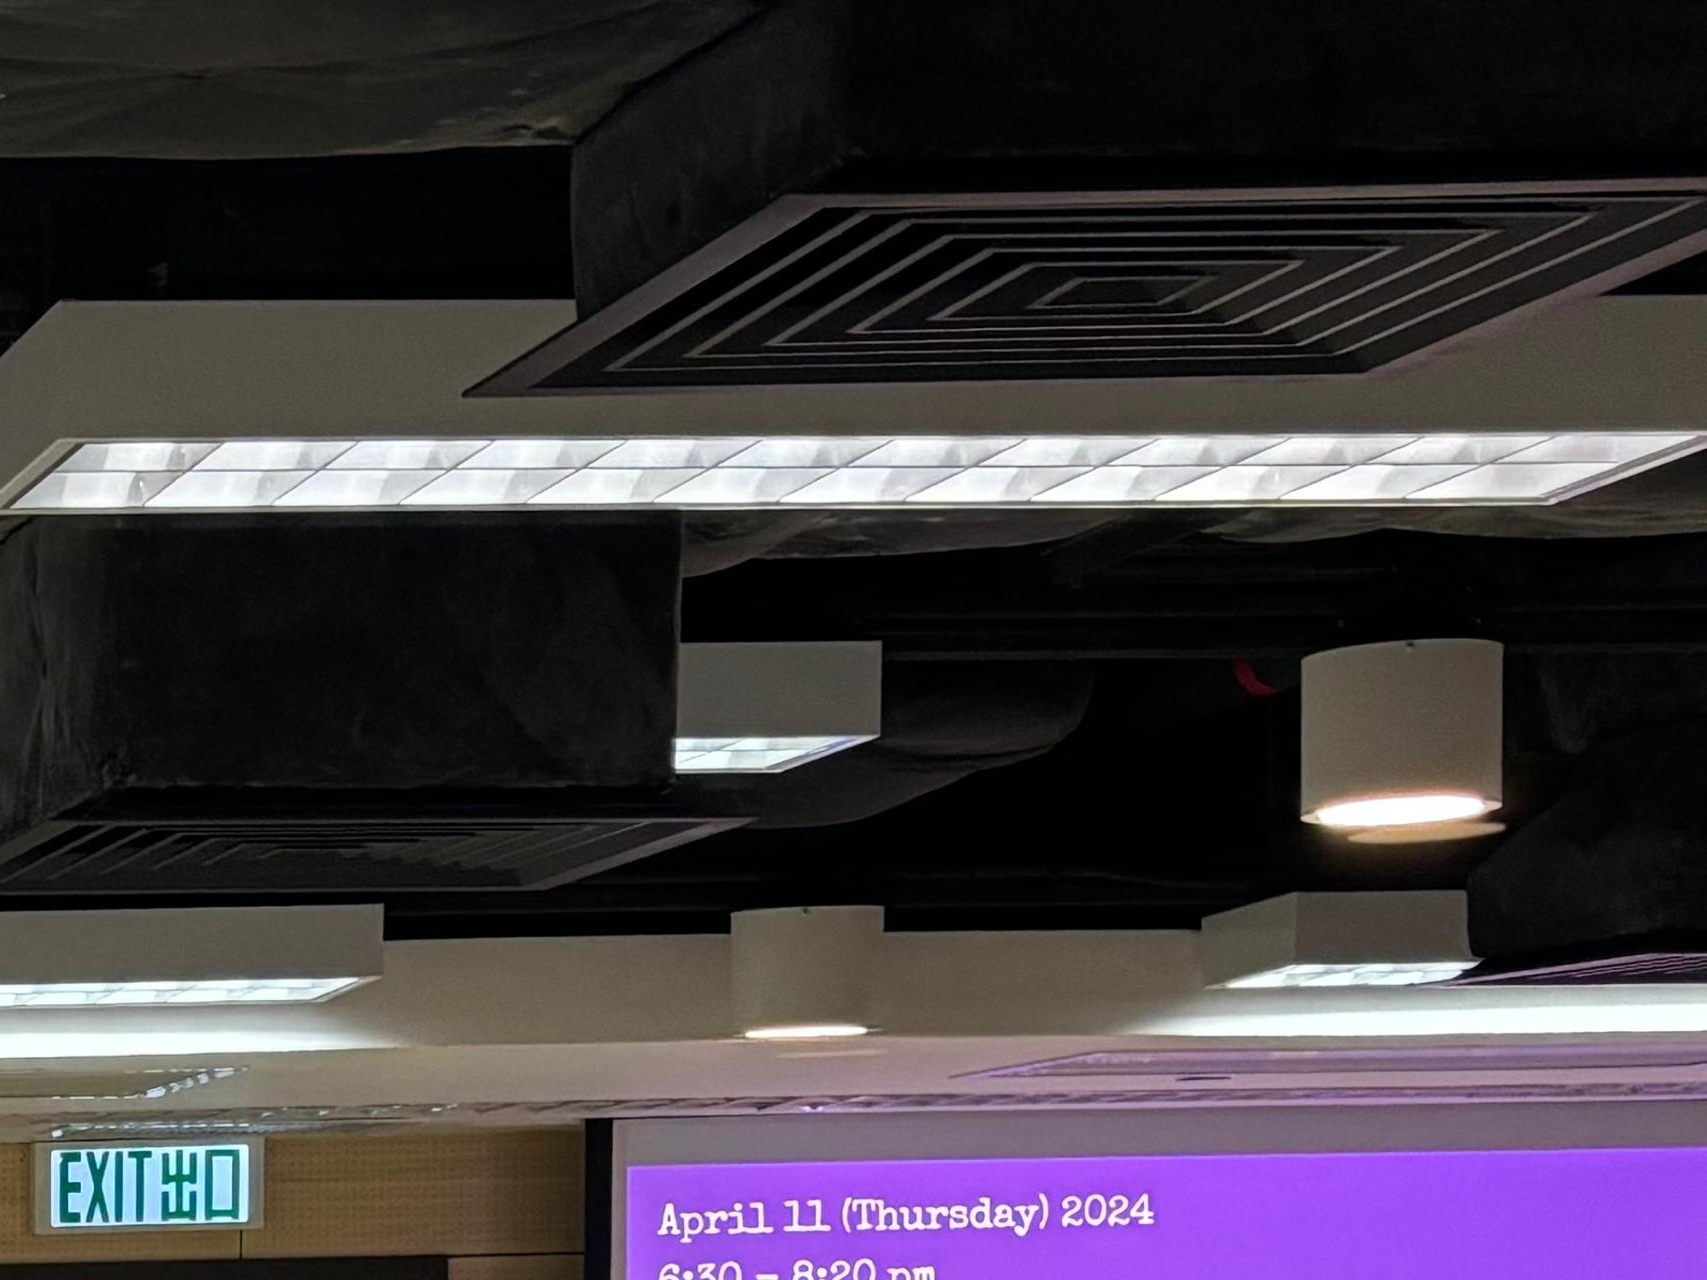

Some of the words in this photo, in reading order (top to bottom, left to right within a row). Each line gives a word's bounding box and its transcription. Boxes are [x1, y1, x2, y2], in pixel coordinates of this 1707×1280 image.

[60, 1151, 152, 1222] EXIT
[161, 1149, 240, 1221] 出口
[657, 1203, 774, 1243] April
[783, 1200, 831, 1231] 11
[842, 1193, 1049, 1237] (Thursday)
[1061, 1193, 1155, 1228] 2024
